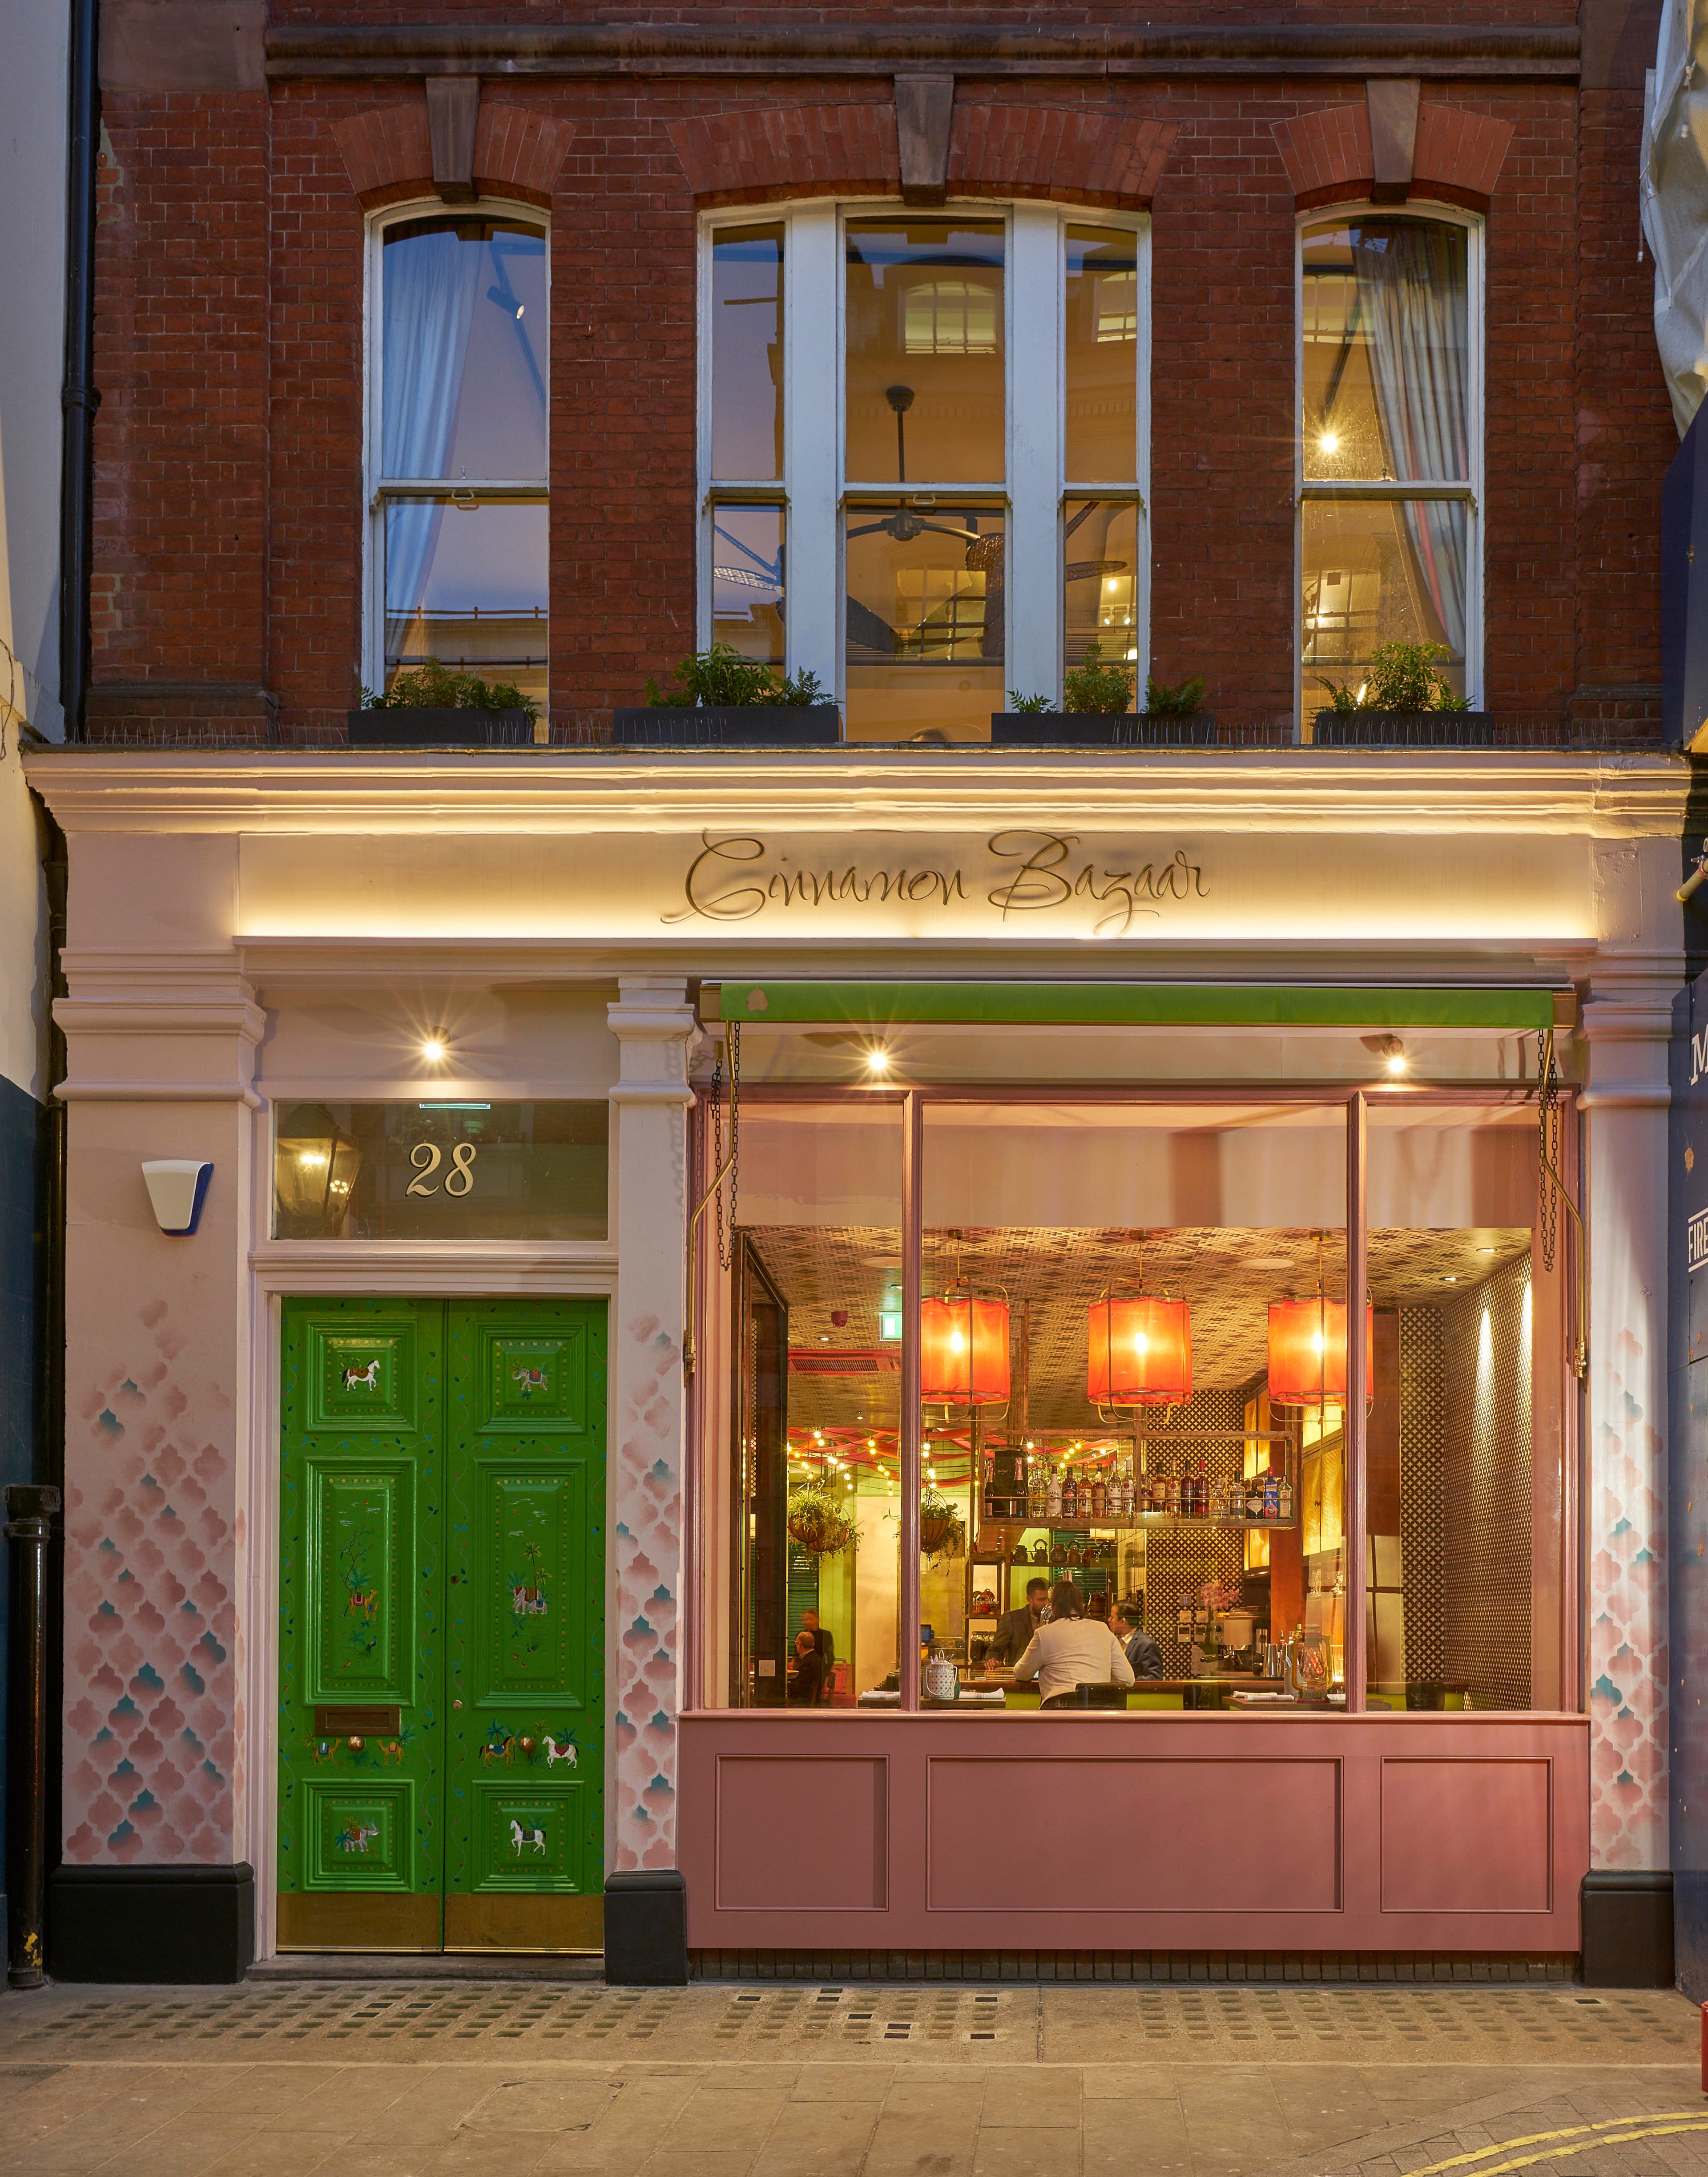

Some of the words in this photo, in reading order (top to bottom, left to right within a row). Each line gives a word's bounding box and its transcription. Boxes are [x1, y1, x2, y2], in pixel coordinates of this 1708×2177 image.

[661, 828, 970, 924] Cinnamon
[987, 829, 1211, 937] Bazaar
[405, 1143, 476, 1197] 28
[1688, 1216, 1708, 1264] FIRE
